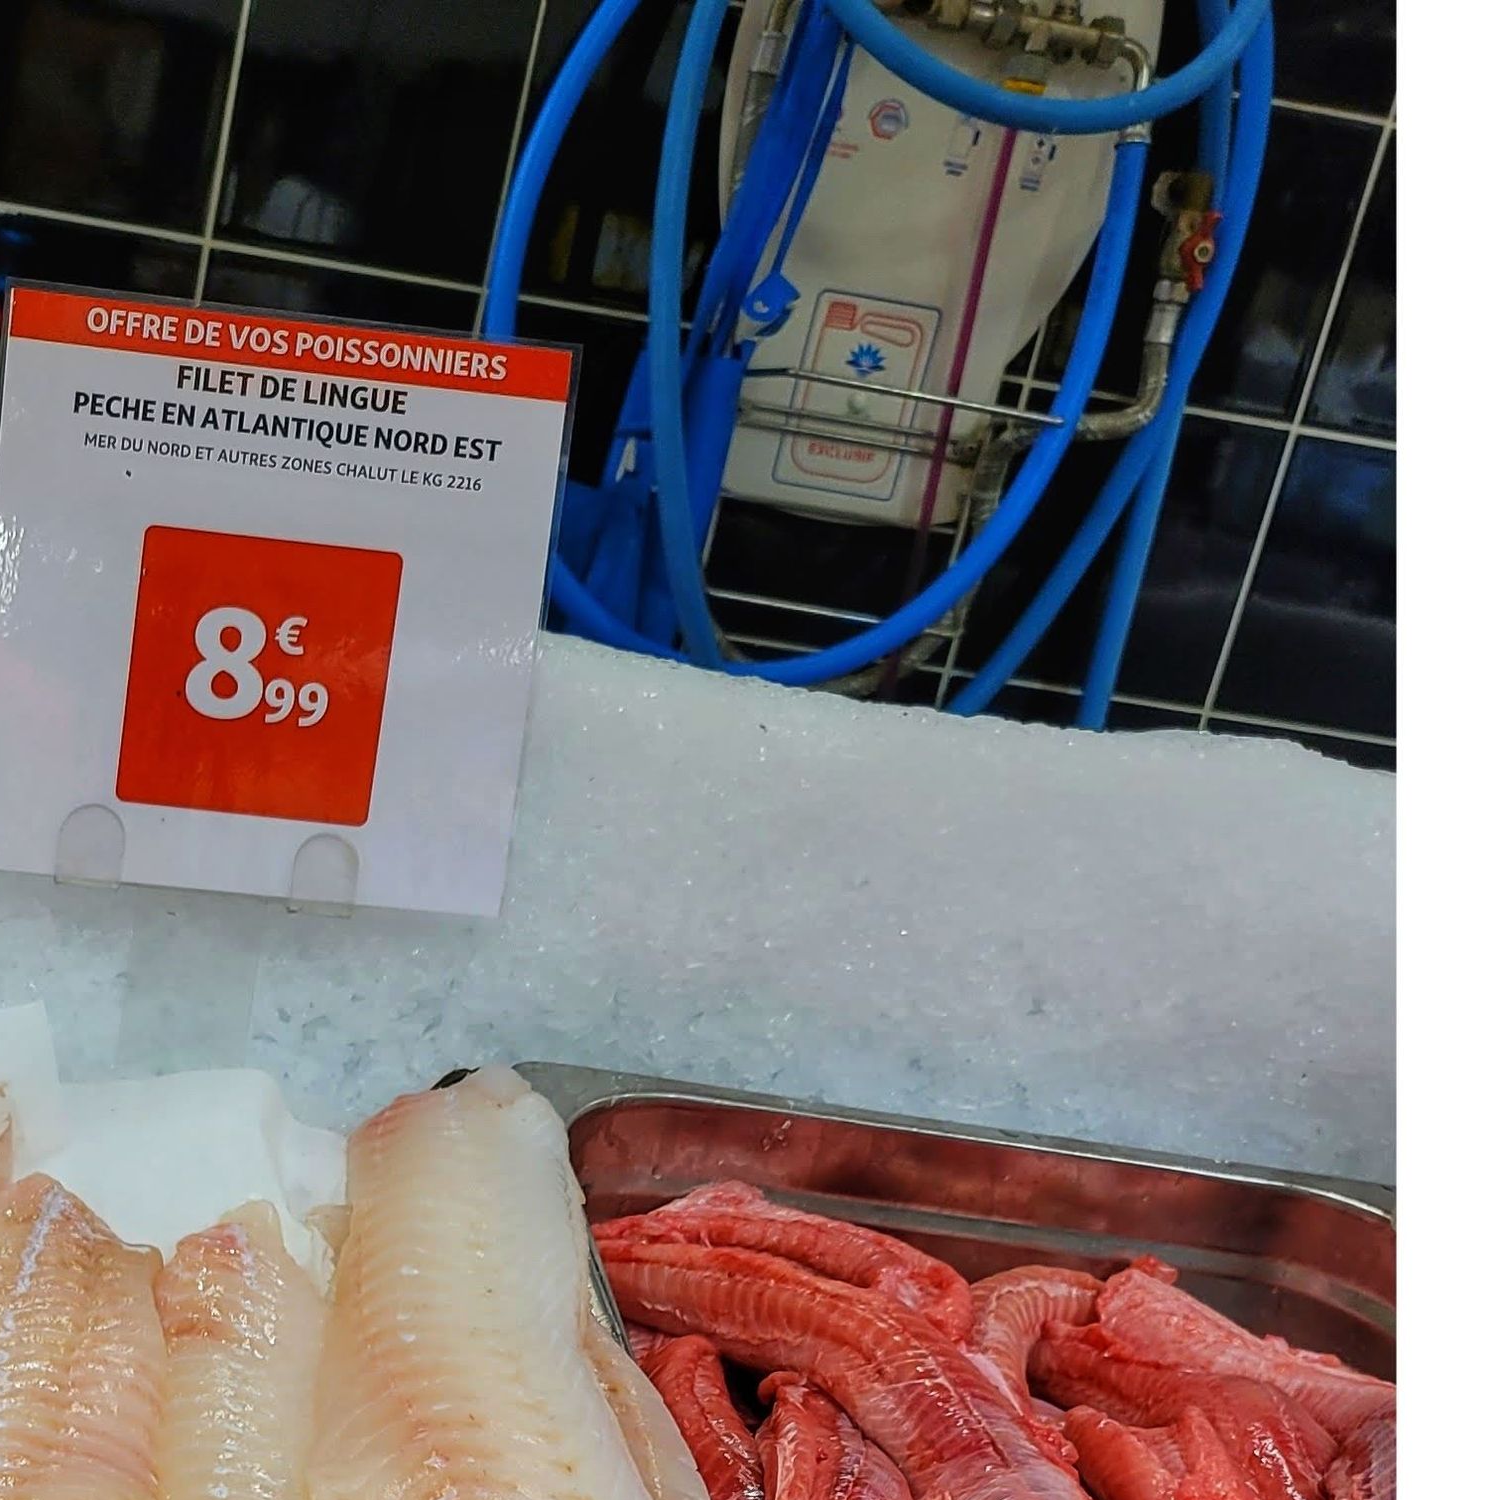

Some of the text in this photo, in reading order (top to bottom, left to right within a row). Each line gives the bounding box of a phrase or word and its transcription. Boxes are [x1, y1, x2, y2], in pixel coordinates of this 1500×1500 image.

[87, 306, 508, 381] OFFRE DE VOS POISSONNIERS
[177, 364, 408, 414] FILET DE LINGUE
[73, 391, 503, 463] PECHE EN ATLANTIQUE NORD EST
[84, 432, 482, 492] MER DU NORD ET AUTRES ZONES CHALUT LE KG 2216
[185, 606, 329, 727] 8 € 99
